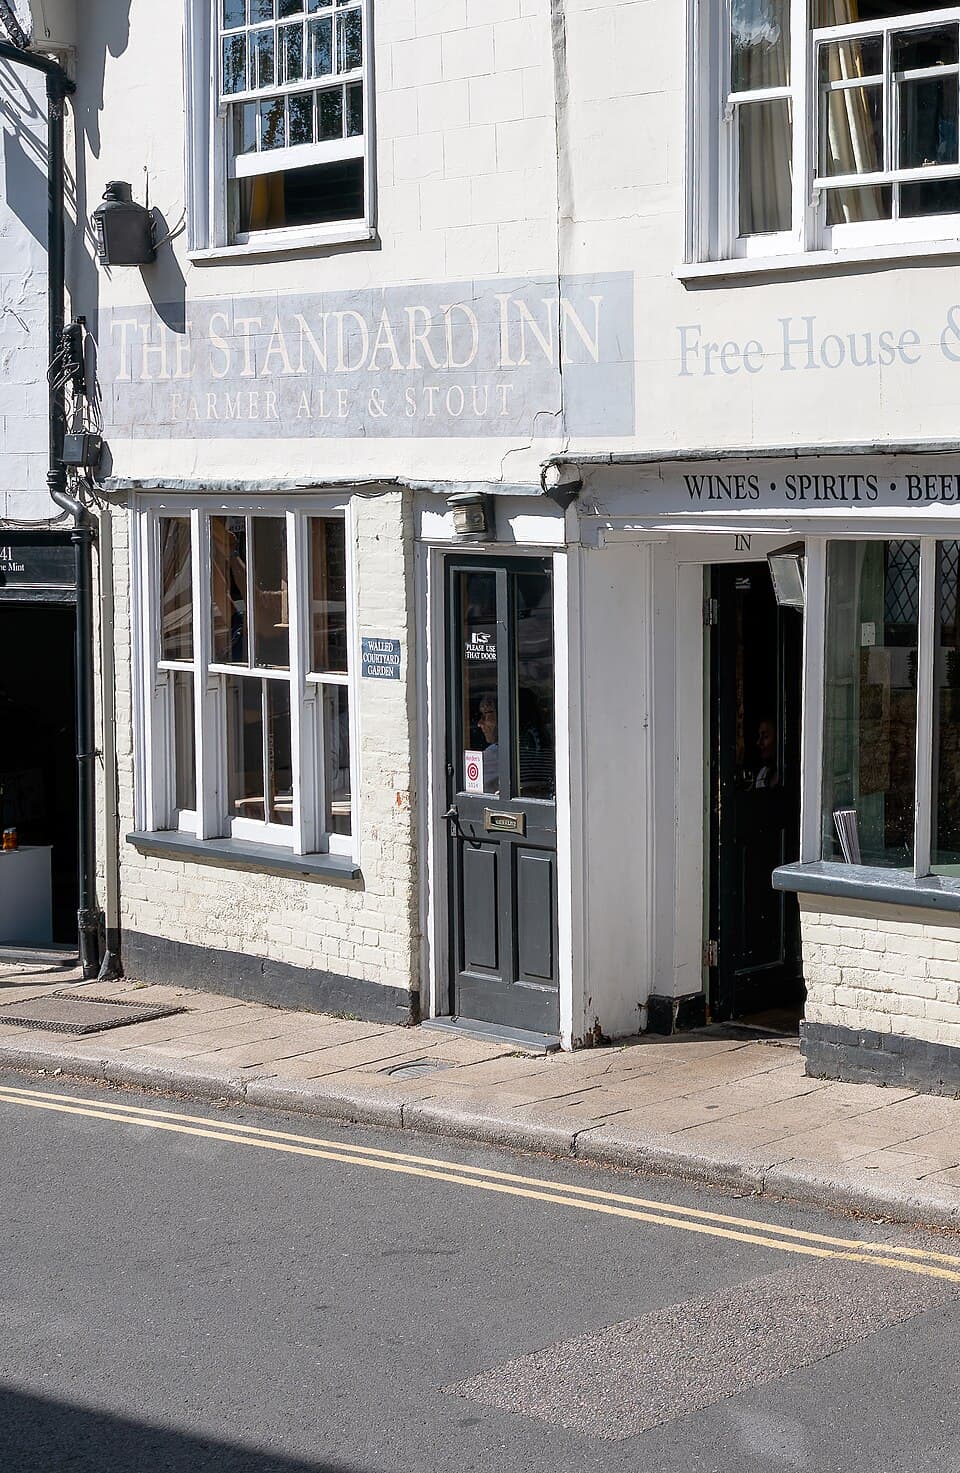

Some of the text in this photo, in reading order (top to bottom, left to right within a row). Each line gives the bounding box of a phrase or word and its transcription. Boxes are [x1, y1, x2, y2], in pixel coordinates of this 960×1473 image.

[111, 292, 604, 381] THE STANDARD INN
[677, 324, 765, 377] Free
[777, 315, 922, 372] House
[170, 384, 514, 420] FARMER ALE & STOUT
[683, 474, 761, 501] WINES
[785, 474, 879, 502] SPIRITS
[734, 534, 752, 551] IN
[8, 562, 25, 572] Mint
[367, 640, 394, 652] WALLED
[465, 644, 485, 652] PLEASE
[362, 652, 400, 665] COURTYARD
[465, 651, 497, 660] THAT DOOR
[367, 665, 394, 677] GARDEN
